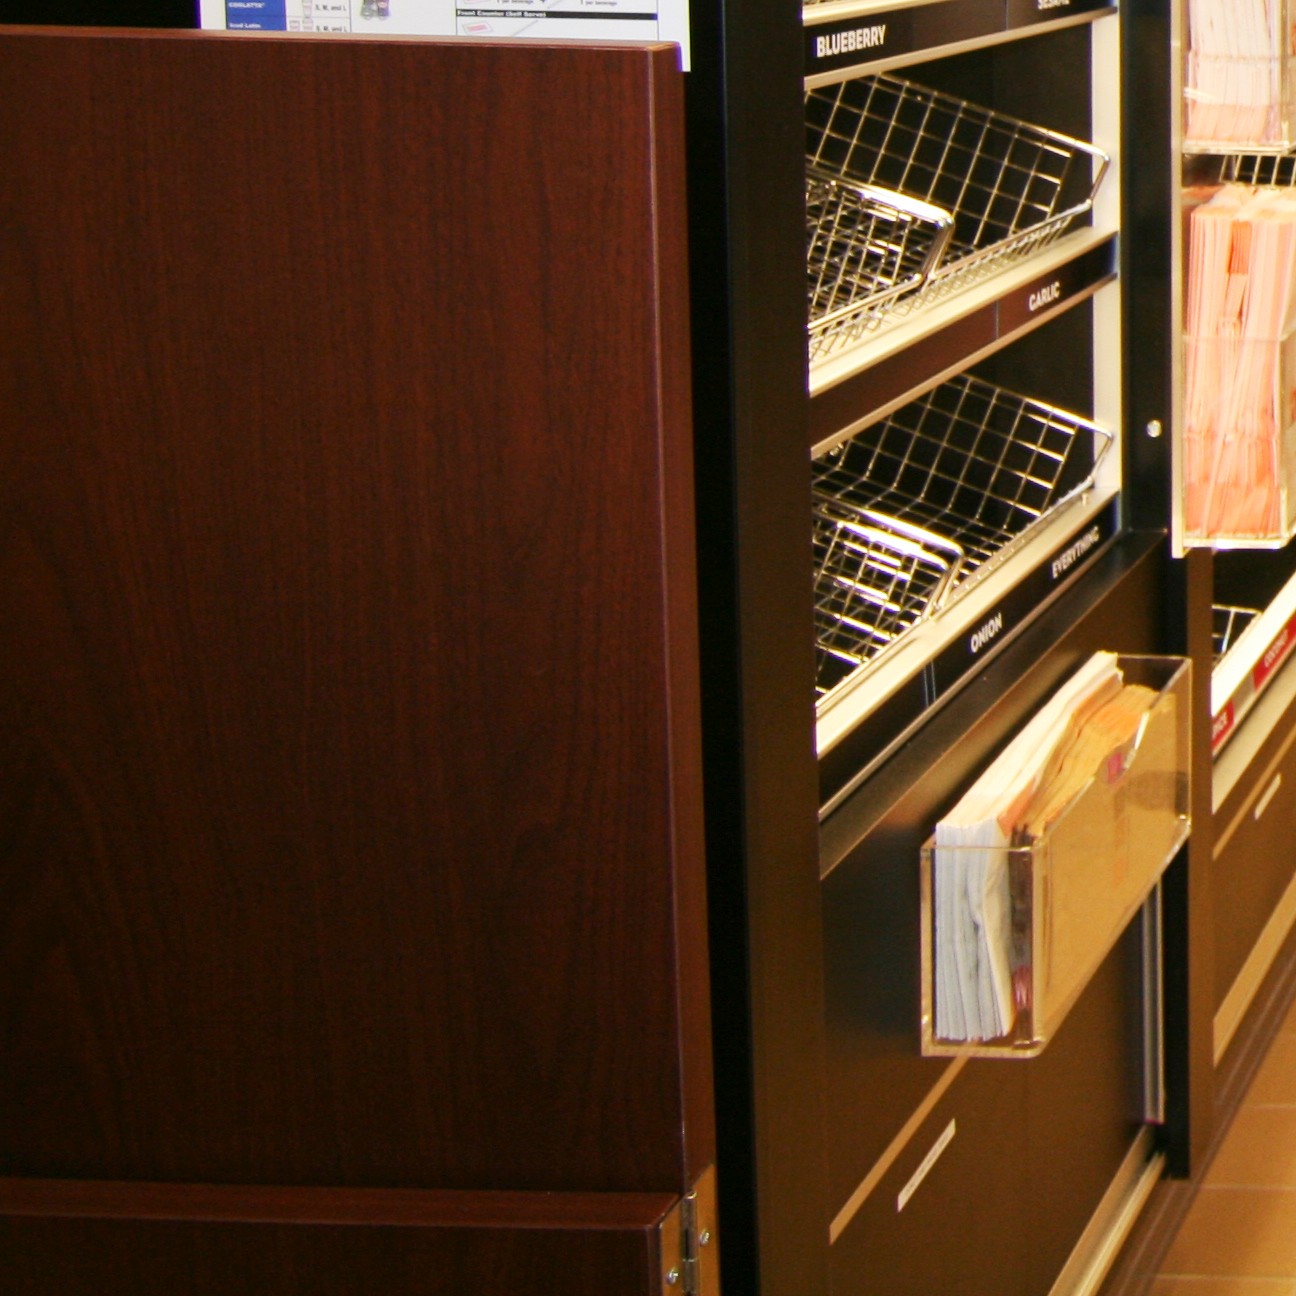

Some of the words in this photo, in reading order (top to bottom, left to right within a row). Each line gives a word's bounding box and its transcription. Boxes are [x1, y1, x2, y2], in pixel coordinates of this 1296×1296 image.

[816, 24, 887, 58] BLUEBERRY
[1028, 280, 1062, 311] GARLIC
[1051, 525, 1100, 580] EVERYTHING
[970, 611, 1003, 654] ONION
